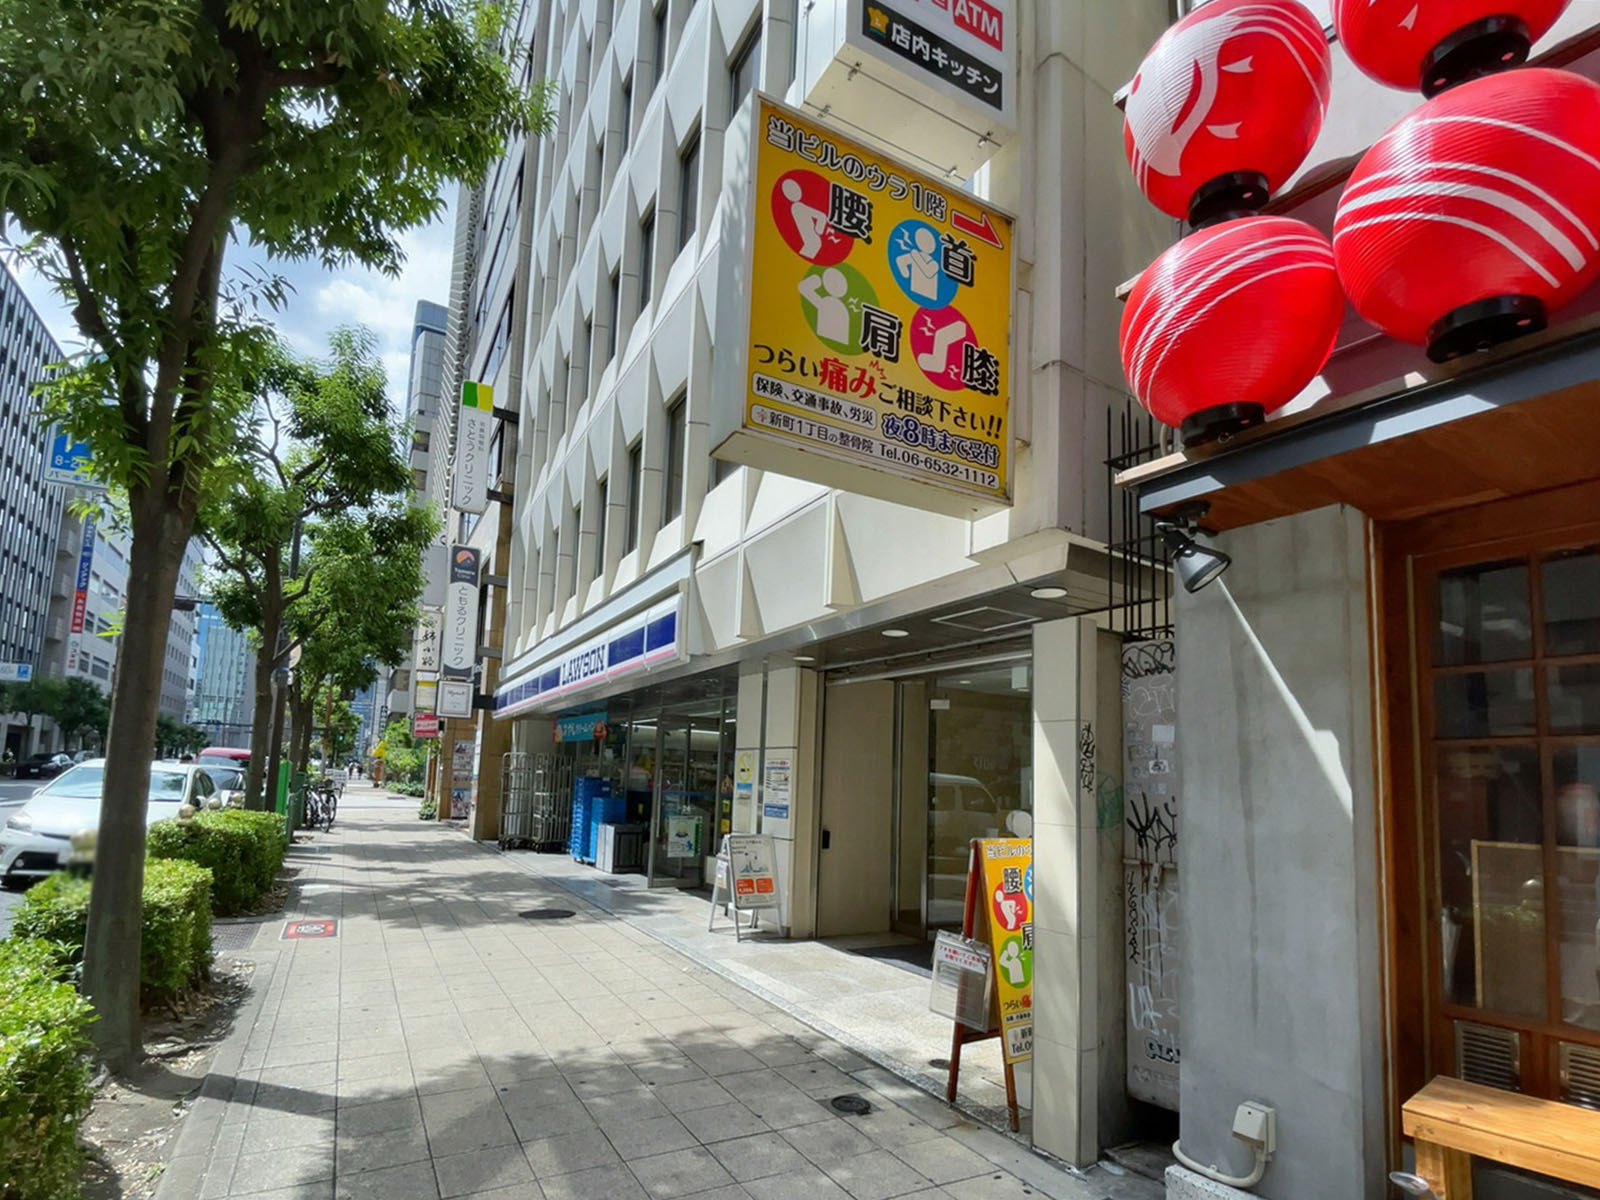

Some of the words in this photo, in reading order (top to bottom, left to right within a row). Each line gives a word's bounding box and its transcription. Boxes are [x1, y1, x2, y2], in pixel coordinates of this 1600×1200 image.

[955, 0, 1000, 42] ATM
[890, 21, 1000, 95] 店内キッチン
[767, 114, 948, 223] 当ビルのウラ1階
[828, 182, 873, 244] 腰
[940, 232, 977, 287] 首
[860, 303, 903, 363] 肩
[961, 342, 999, 396] 膝
[755, 376, 874, 427] 保険、交通事故、労災
[769, 411, 874, 455] 新町1丁目の整骨院
[881, 412, 1000, 469] 夜8時まで受付
[462, 418, 477, 506] さとうクリニック
[562, 644, 606, 686] LAWSON
[1002, 867, 1023, 895] 腰
